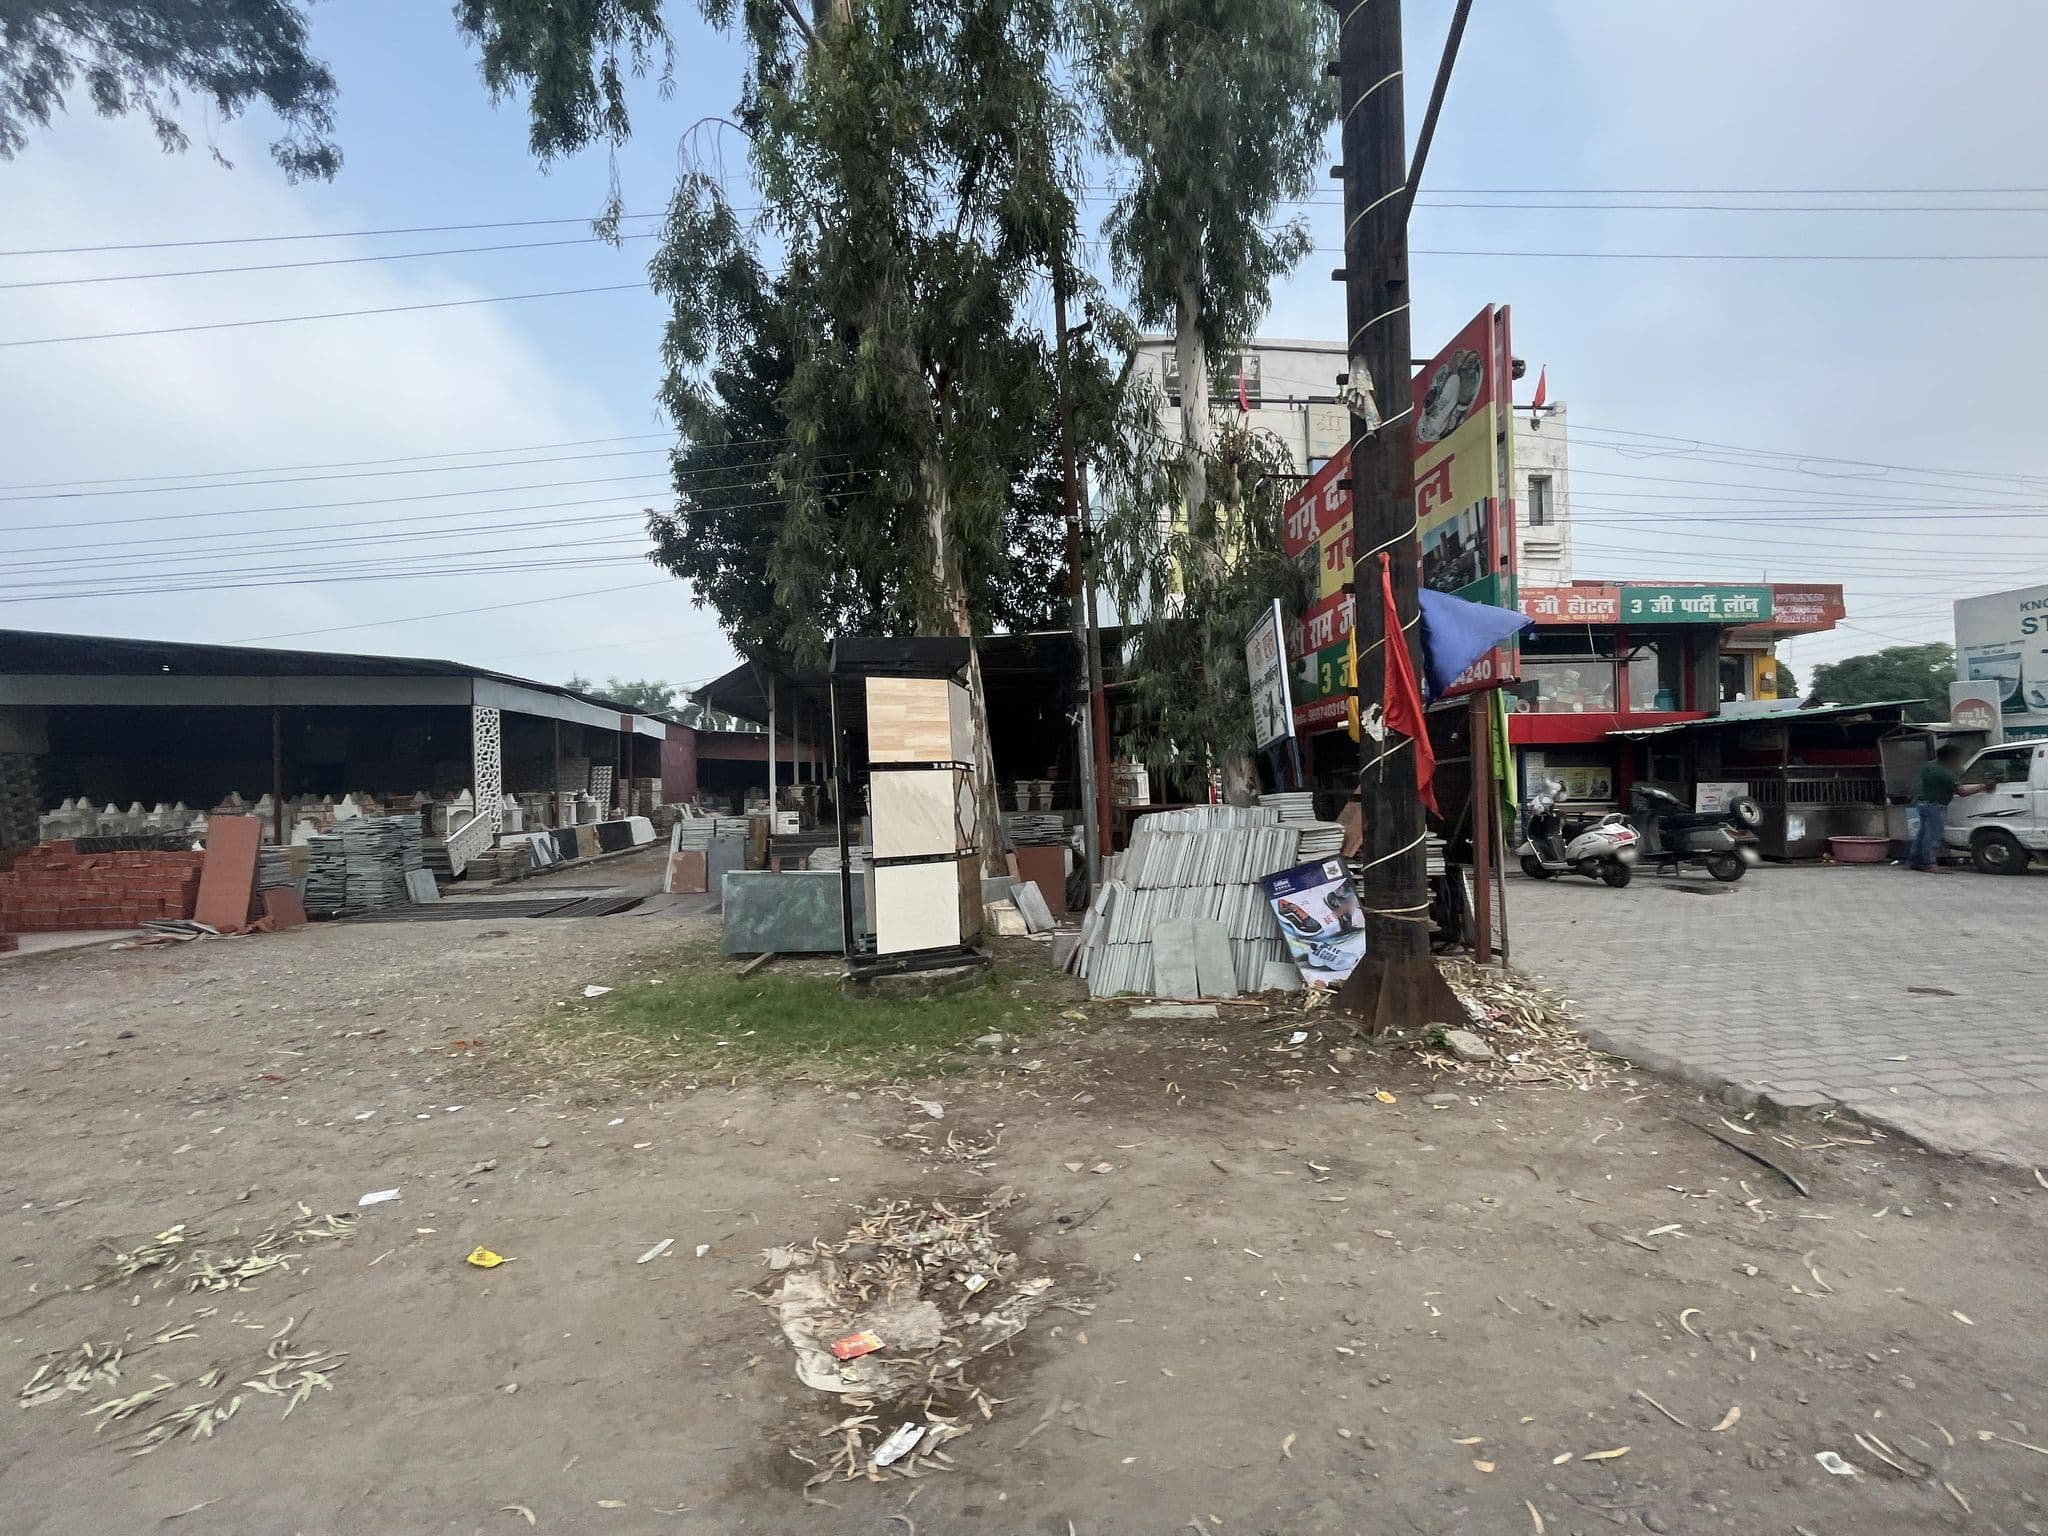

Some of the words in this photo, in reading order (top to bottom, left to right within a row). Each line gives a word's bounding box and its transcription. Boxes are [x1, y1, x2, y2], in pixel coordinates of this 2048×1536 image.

[1288, 494, 1320, 542] गंगू
[1323, 465, 1349, 512] दा
[1415, 452, 1456, 518] ल
[1533, 594, 1560, 615] जी
[1566, 594, 1616, 614] होटल
[1630, 598, 1642, 614] 3
[1648, 594, 1675, 613] जी
[1680, 594, 1717, 613] पार्टी
[1721, 594, 1759, 613] लॉन
[1308, 608, 1334, 650] राम
[1321, 661, 1332, 694] 3
